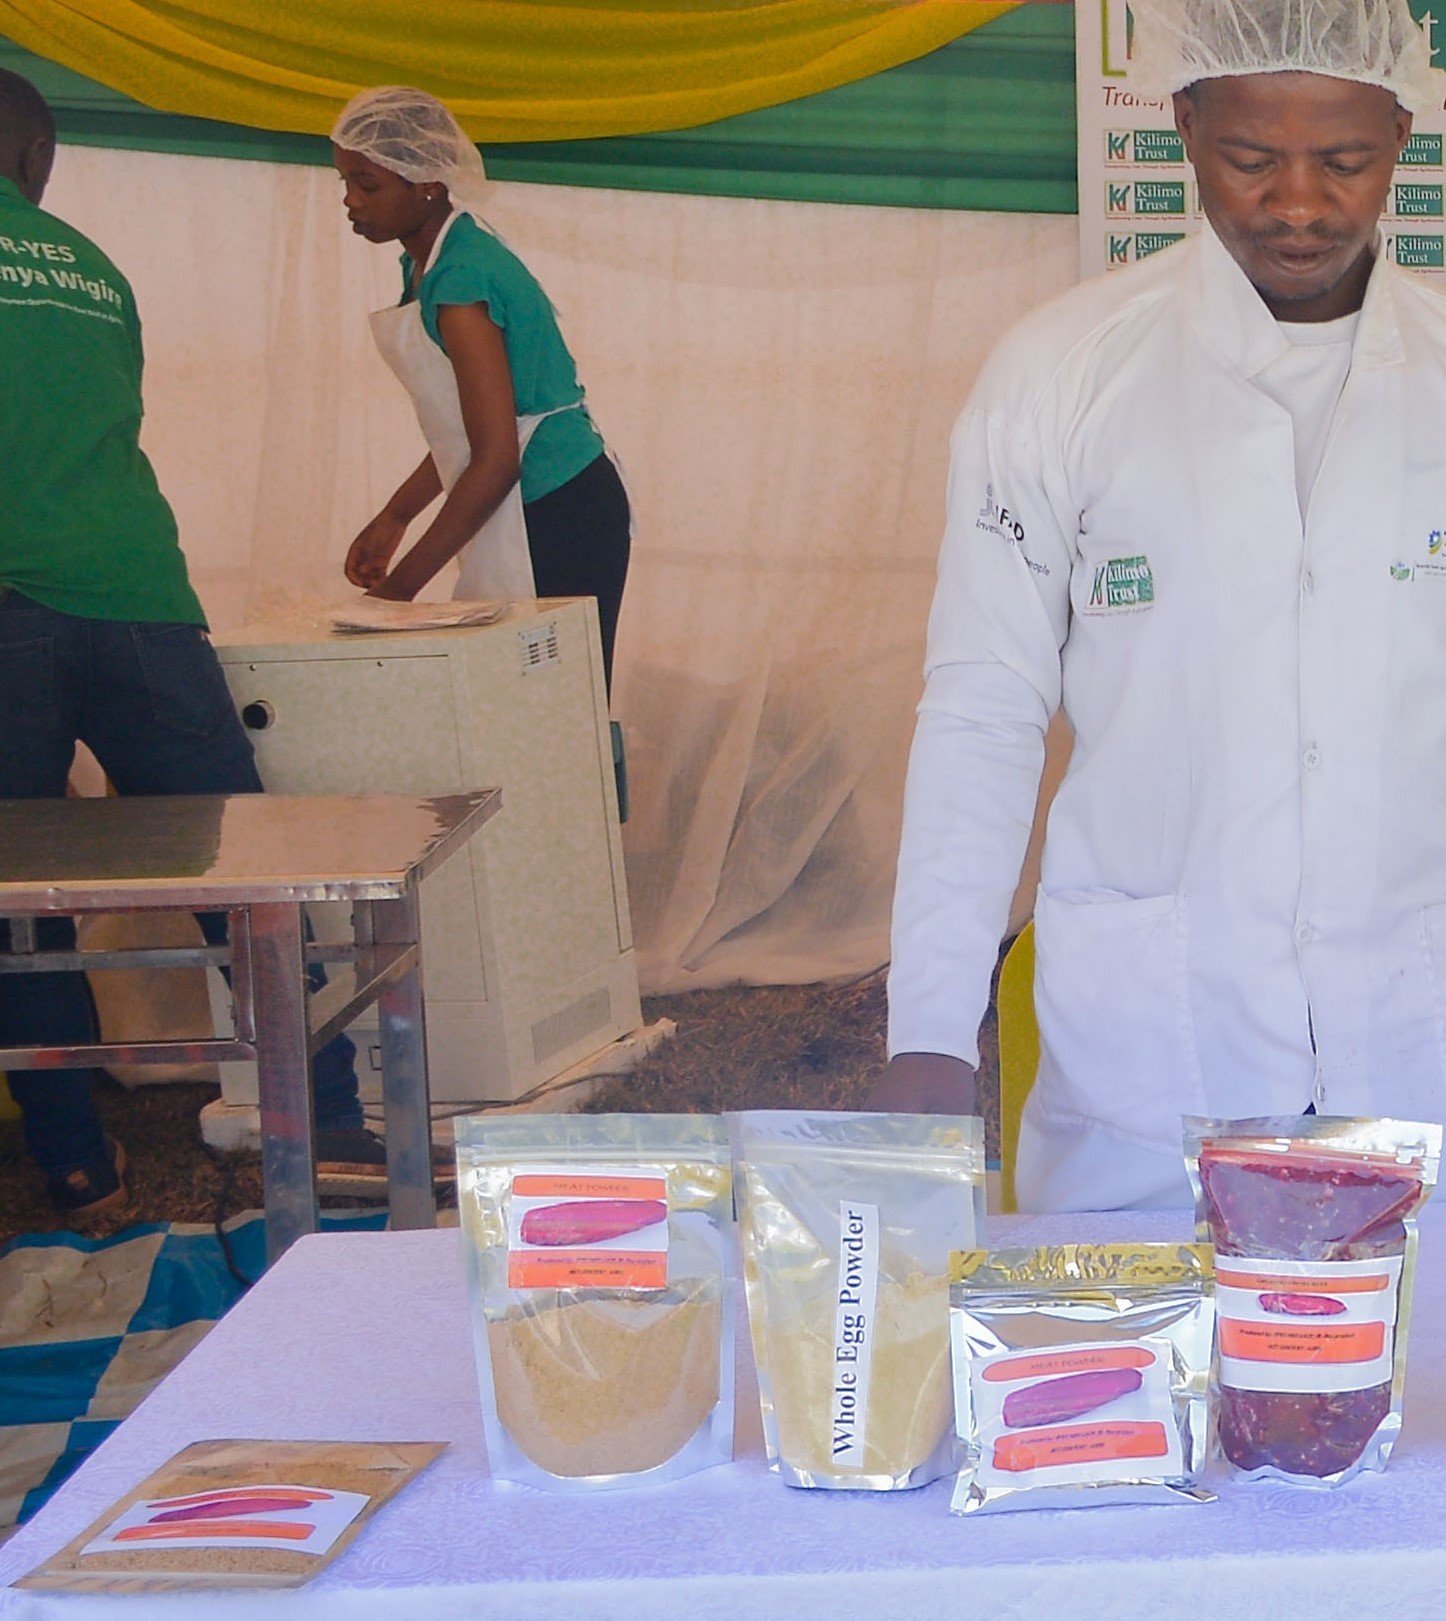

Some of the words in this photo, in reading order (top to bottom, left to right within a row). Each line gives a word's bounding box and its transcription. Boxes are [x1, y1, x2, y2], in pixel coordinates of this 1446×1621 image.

[1135, 132, 1182, 146] Kilimo
[1136, 146, 1168, 159] Trust
[1398, 151, 1428, 163] Trust
[1136, 184, 1183, 198] Kilimo
[1397, 185, 1442, 200] Kilimo
[1137, 198, 1169, 211] Trust
[1398, 200, 1428, 213] Trust
[1398, 236, 1442, 250] Kilimo
[1398, 251, 1429, 264] Trust
[839, 1210, 864, 1306] Powder
[836, 1314, 866, 1363] Egg
[833, 1373, 857, 1455] Whole
